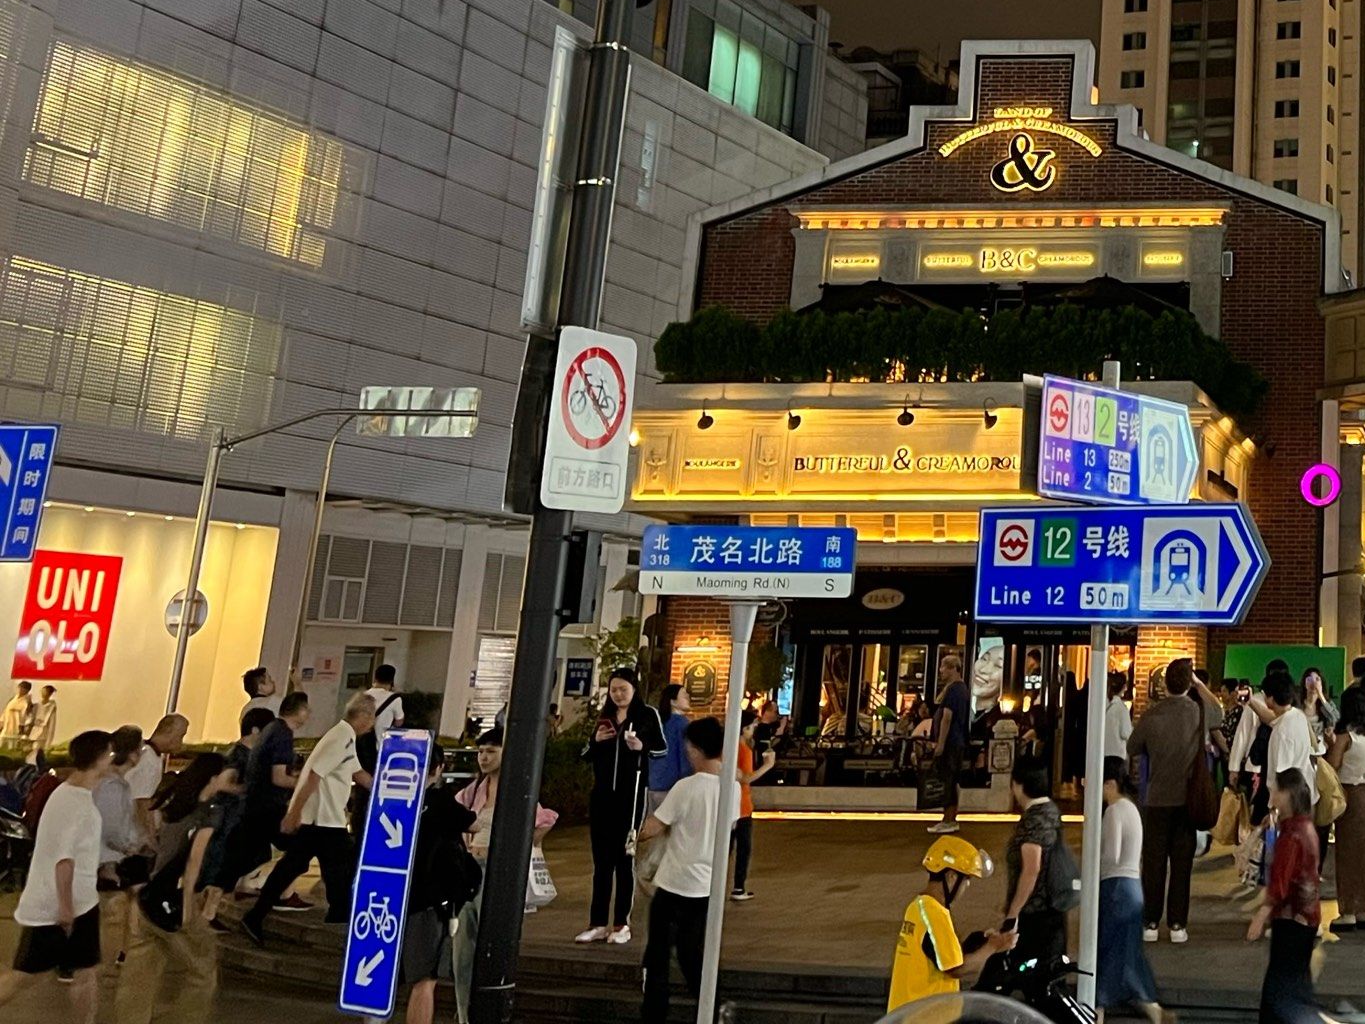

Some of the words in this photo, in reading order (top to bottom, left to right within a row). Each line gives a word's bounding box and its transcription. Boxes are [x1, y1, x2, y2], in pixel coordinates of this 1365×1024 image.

[990, 132, 1056, 192] &
[979, 248, 1036, 272] B&C
[1077, 399, 1090, 435] 13
[1098, 403, 1111, 439] 2
[1118, 410, 1140, 444] 号线
[794, 456, 889, 471] BUTTERFUL
[893, 448, 912, 471] &
[916, 456, 1020, 471] CREAMOROU
[1044, 441, 1071, 462] Line
[1083, 449, 1096, 466] 13
[1109, 450, 1130, 471] 250m
[557, 465, 614, 490] 前方路口
[1043, 466, 1070, 486] Line
[1084, 472, 1092, 490] 2
[1109, 477, 1129, 493] 50m
[12, 443, 47, 544] 限时期间
[655, 534, 670, 551] 北
[690, 536, 803, 565] 茂名北路
[825, 535, 841, 553] 南
[1044, 527, 1072, 559] 12
[1082, 525, 1130, 559] 号线
[650, 554, 671, 566] 318
[822, 556, 842, 568] 188
[37, 566, 105, 612] UNI
[652, 576, 663, 589] N
[696, 577, 748, 591] Maoming
[824, 579, 835, 592] S
[991, 586, 1032, 605] Line
[1045, 586, 1065, 605] 12
[1086, 586, 1124, 608] 50m
[28, 619, 100, 671] QLO
